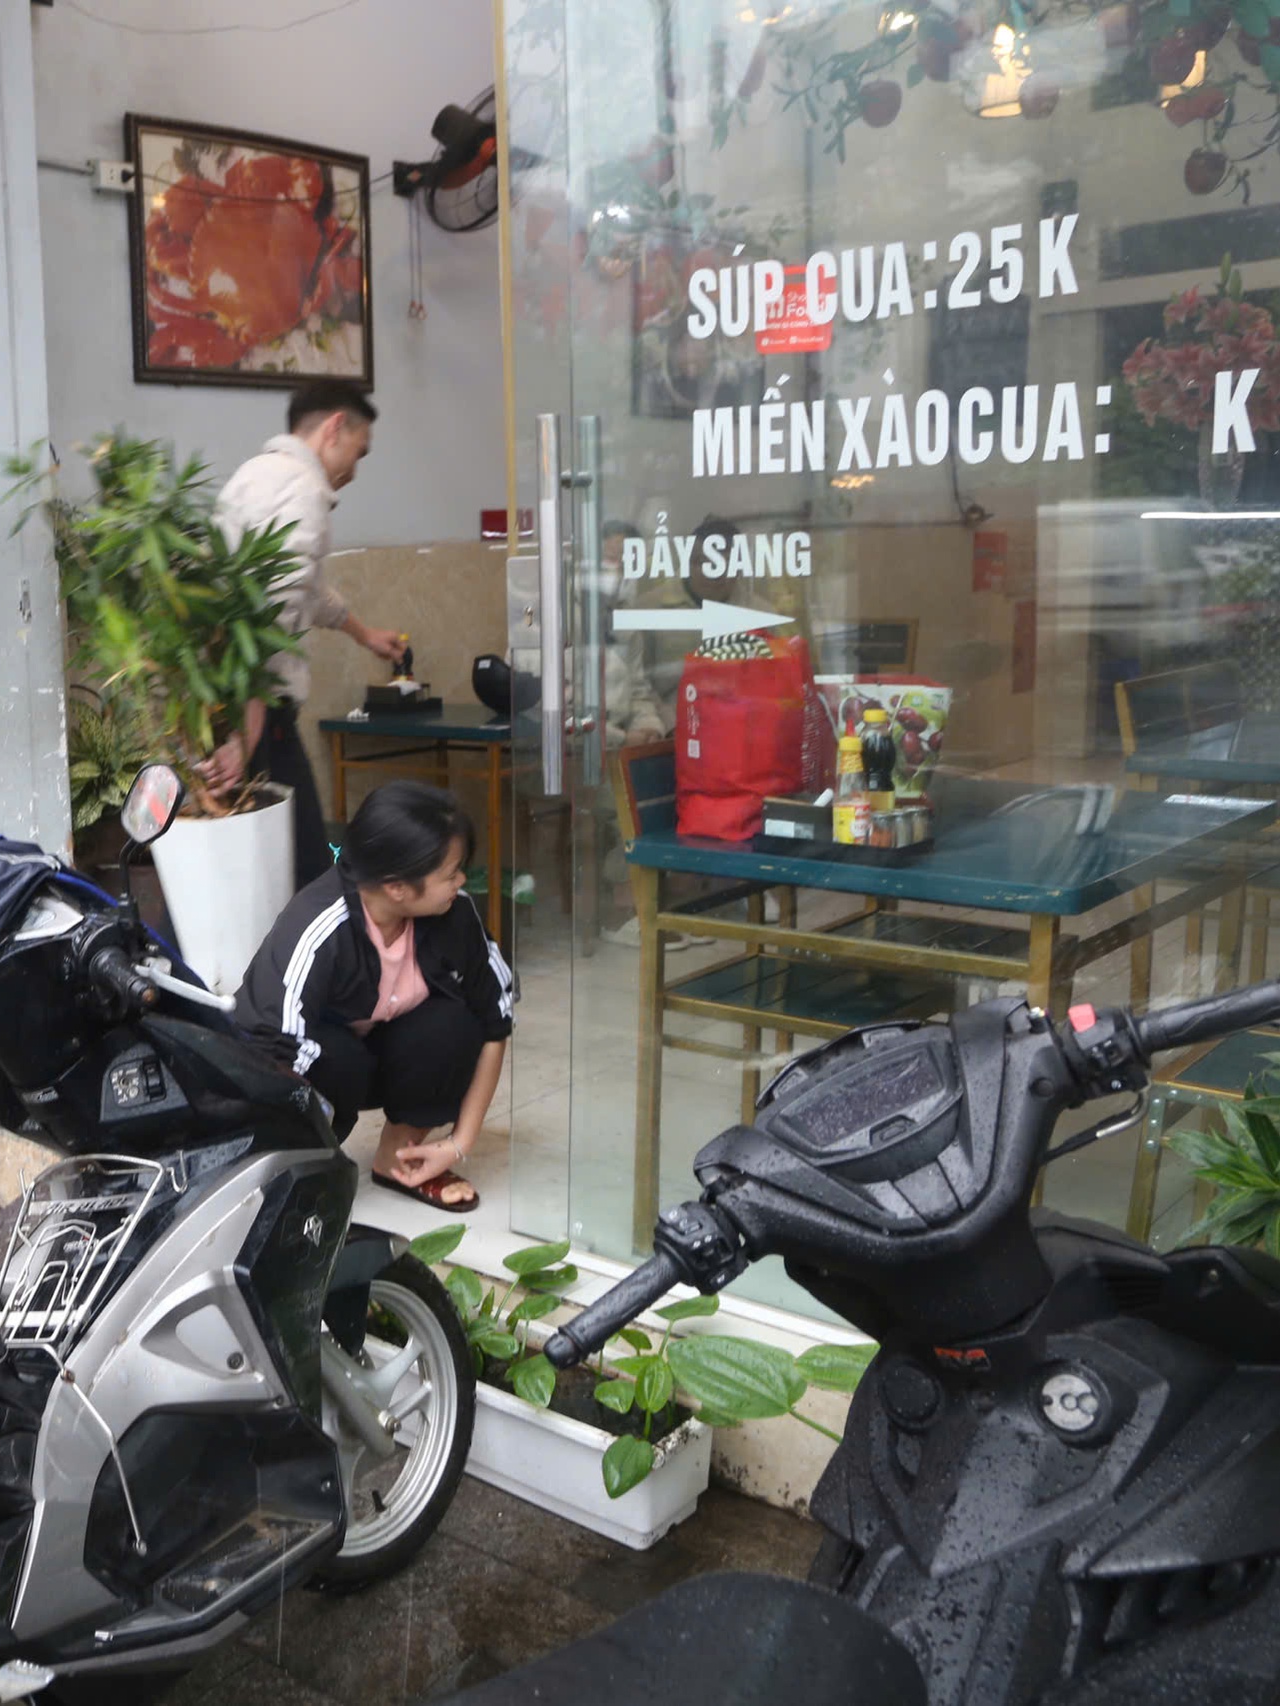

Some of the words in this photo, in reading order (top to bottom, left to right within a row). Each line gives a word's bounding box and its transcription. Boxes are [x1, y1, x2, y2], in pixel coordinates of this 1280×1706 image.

[686, 243, 785, 340] SÚP
[692, 373, 826, 479] MIẾN
[1212, 367, 1262, 455] K
[622, 511, 697, 580] ĐẨY
[701, 531, 812, 579] SANG
